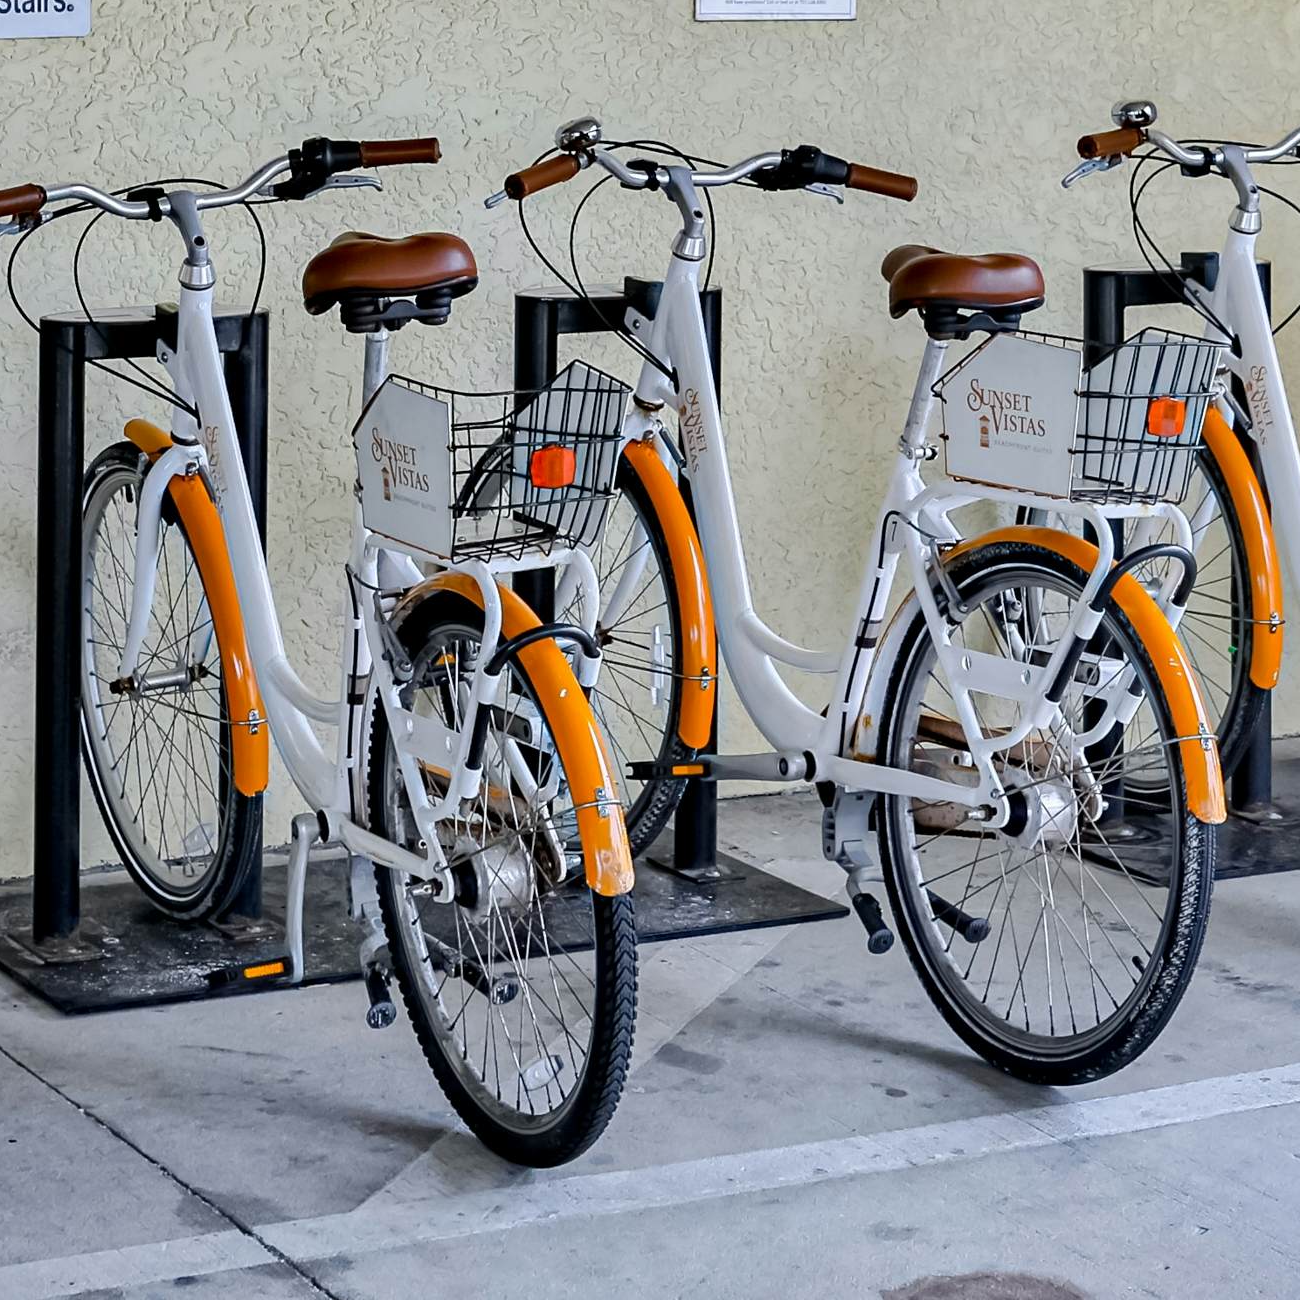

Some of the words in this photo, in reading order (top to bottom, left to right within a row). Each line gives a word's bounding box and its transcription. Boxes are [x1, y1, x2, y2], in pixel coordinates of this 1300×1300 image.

[967, 378, 1032, 412] SUNSET
[990, 405, 1046, 437] VISTAS
[371, 427, 417, 465] SUNSET
[388, 457, 430, 492] VISTAS
[892, 521, 898, 542] 7
